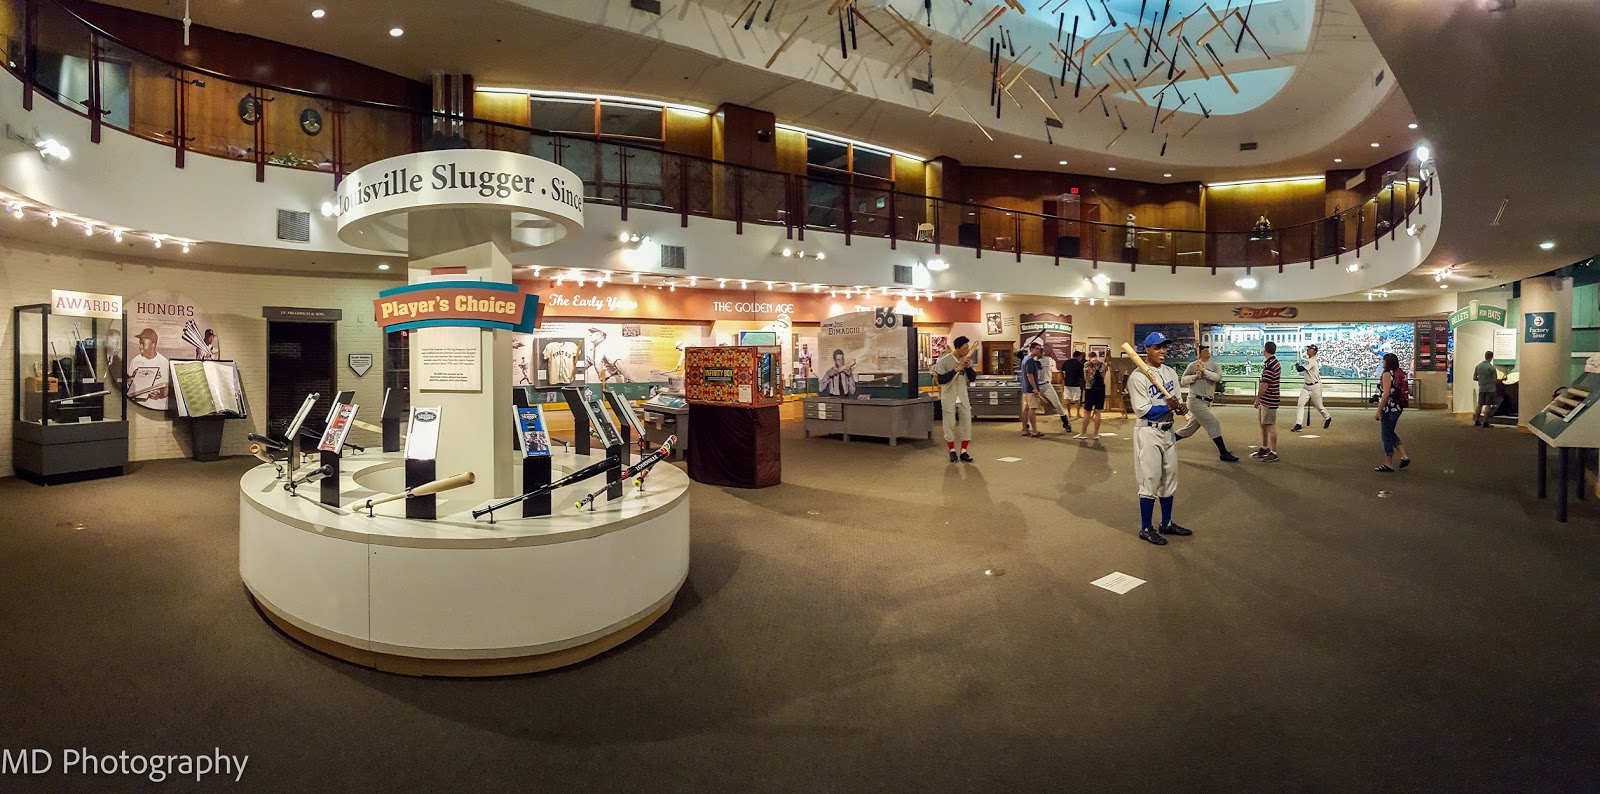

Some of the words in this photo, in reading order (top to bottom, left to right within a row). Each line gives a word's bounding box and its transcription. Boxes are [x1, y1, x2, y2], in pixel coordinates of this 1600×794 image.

[338, 167, 423, 217] Louisville
[431, 162, 535, 198] Slugger
[551, 176, 582, 213] Since
[56, 296, 119, 313] AWARDS
[137, 302, 195, 317] HONORS
[381, 295, 449, 320] Player's
[455, 294, 516, 315] Choice
[549, 293, 570, 306] The
[572, 294, 605, 311] Early
[713, 302, 732, 313] THE
[735, 302, 772, 314] GOLDEN
[775, 303, 794, 314] AGE
[875, 306, 897, 329] 56
[1451, 311, 1469, 325] BILLETS
[1479, 309, 1488, 317] FOR
[1488, 309, 1501, 320] BATS
[635, 454, 659, 471] LOUISVILLE
